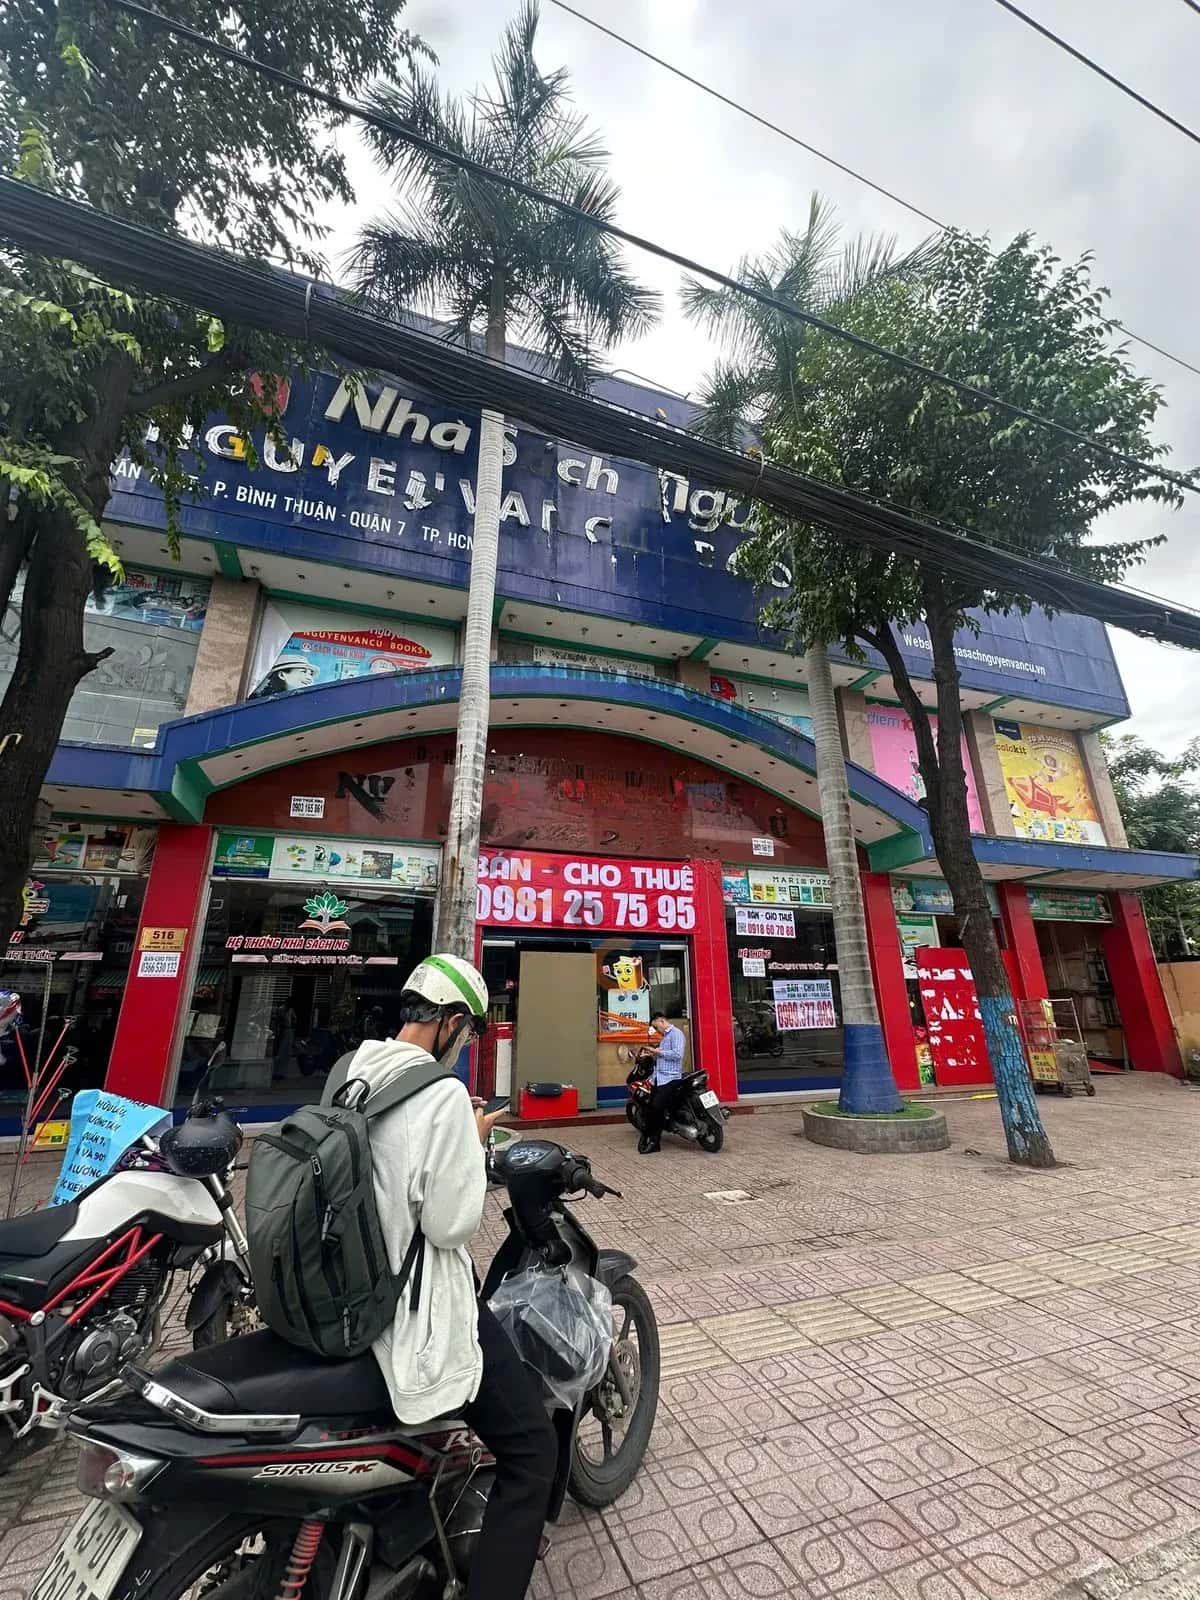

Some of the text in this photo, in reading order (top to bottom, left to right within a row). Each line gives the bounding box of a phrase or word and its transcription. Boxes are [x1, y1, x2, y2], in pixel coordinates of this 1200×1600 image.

[324, 374, 473, 455] Nhà
[213, 481, 228, 499] P.
[235, 485, 277, 510] BÌNH
[284, 496, 337, 522] THUẬN
[349, 511, 391, 533] QUẬN
[398, 521, 406, 536] 7
[422, 525, 443, 545] TP.
[478, 852, 532, 881] BÁN
[564, 862, 621, 887] CHO
[631, 865, 694, 891] THUÊ
[476, 884, 695, 930] 0981 25 75 95
[152, 930, 175, 940] 516
[253, 1462, 351, 1478] SIRIUS
